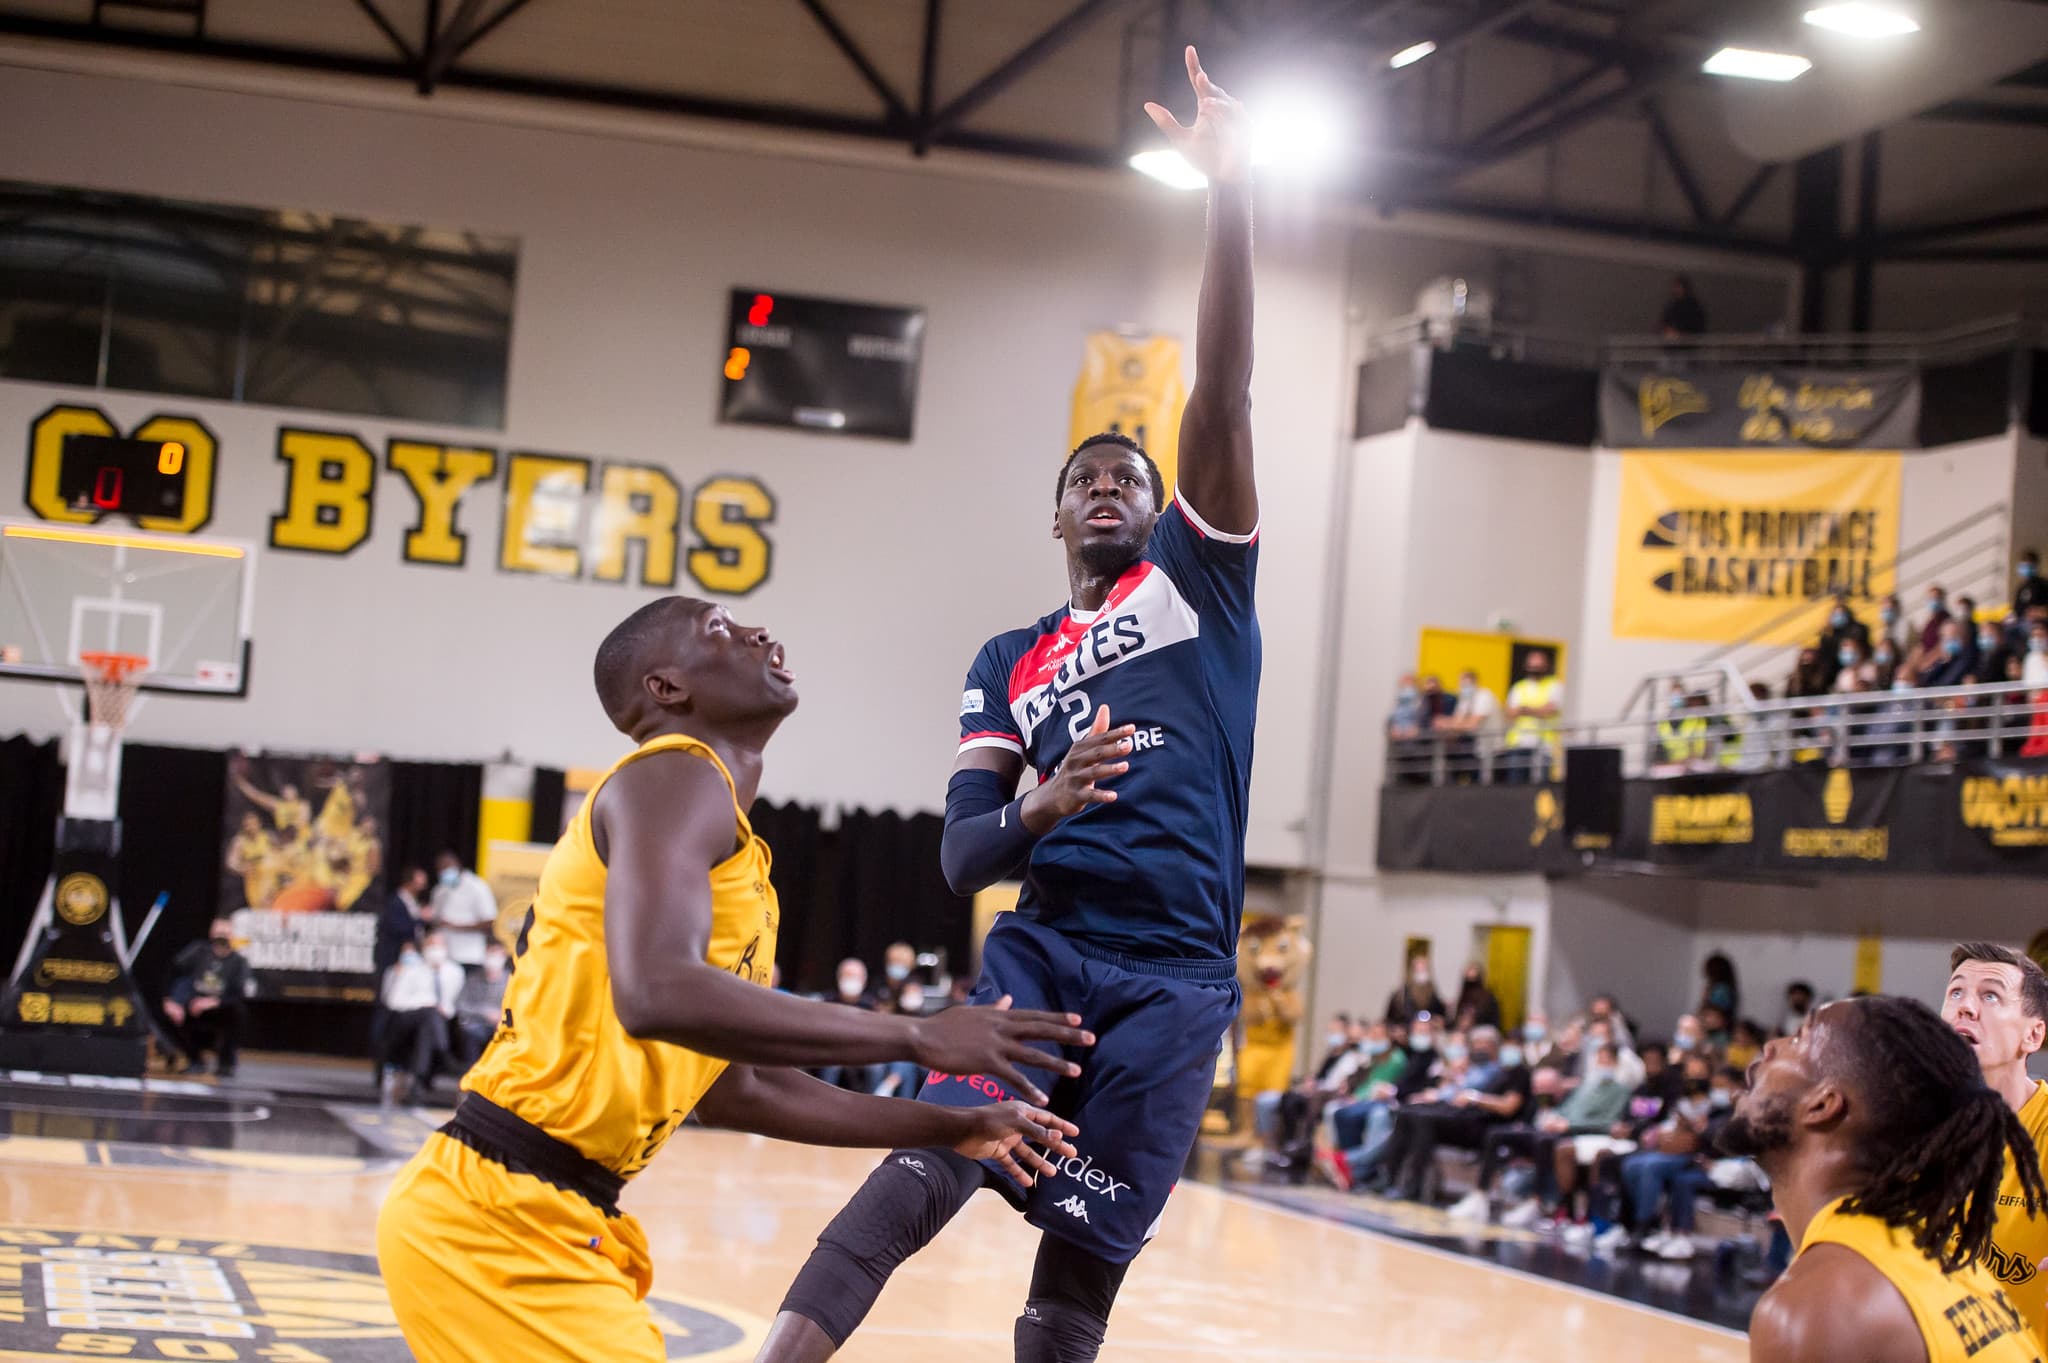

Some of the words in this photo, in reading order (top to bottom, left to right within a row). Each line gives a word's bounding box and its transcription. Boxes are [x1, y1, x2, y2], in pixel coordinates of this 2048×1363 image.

[158, 441, 185, 475] 0
[269, 426, 778, 597] BYERS
[1683, 556, 1873, 598] BASKETBALL
